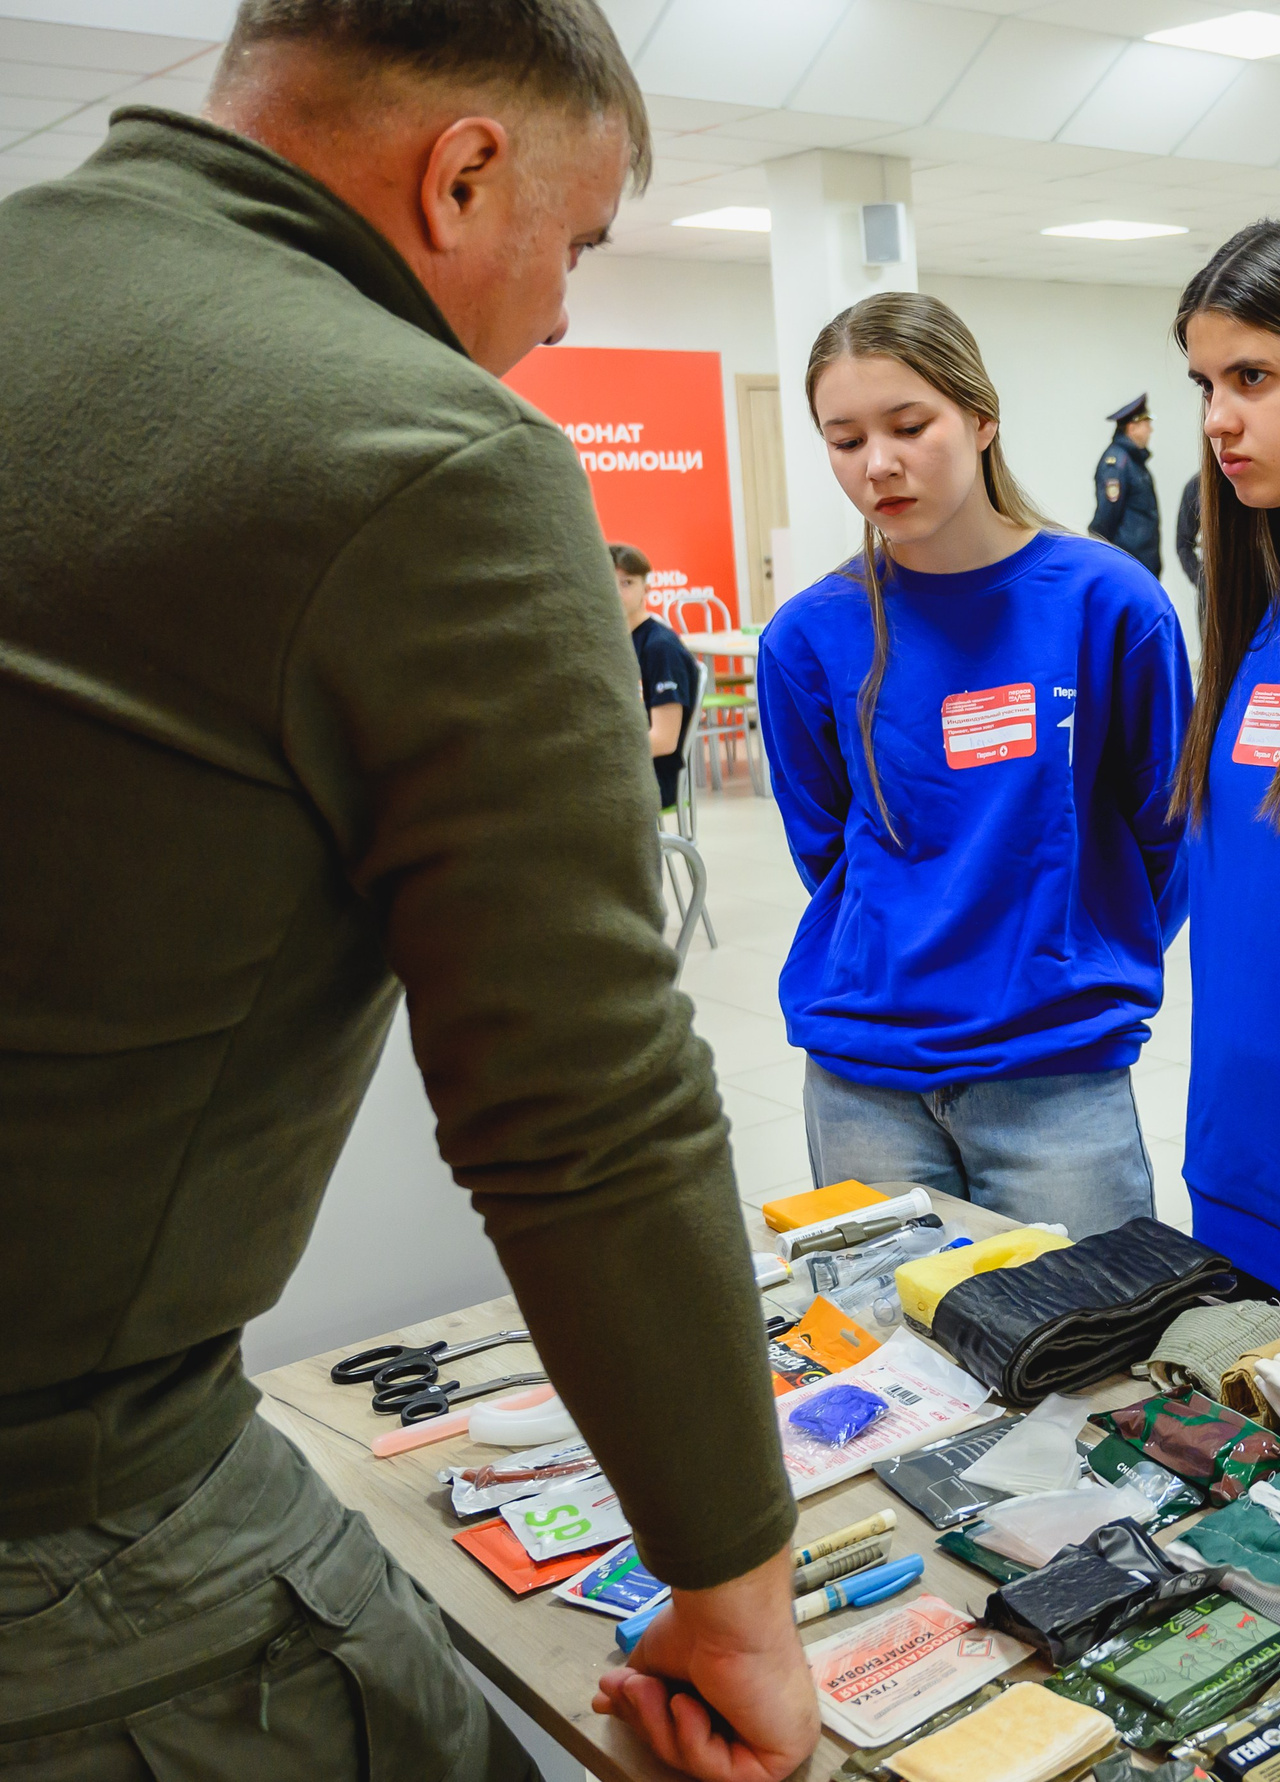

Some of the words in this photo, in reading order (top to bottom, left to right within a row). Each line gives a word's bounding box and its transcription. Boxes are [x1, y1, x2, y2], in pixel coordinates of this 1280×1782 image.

[580, 450, 704, 474] ПОМОЩИ
[827, 1631, 935, 1689] КОЛЛАГЕНОВАЯ
[838, 1623, 971, 1700] ГЕМОСТАТИЧЕСКАЯ
[850, 1679, 899, 1706] ГУБКА
